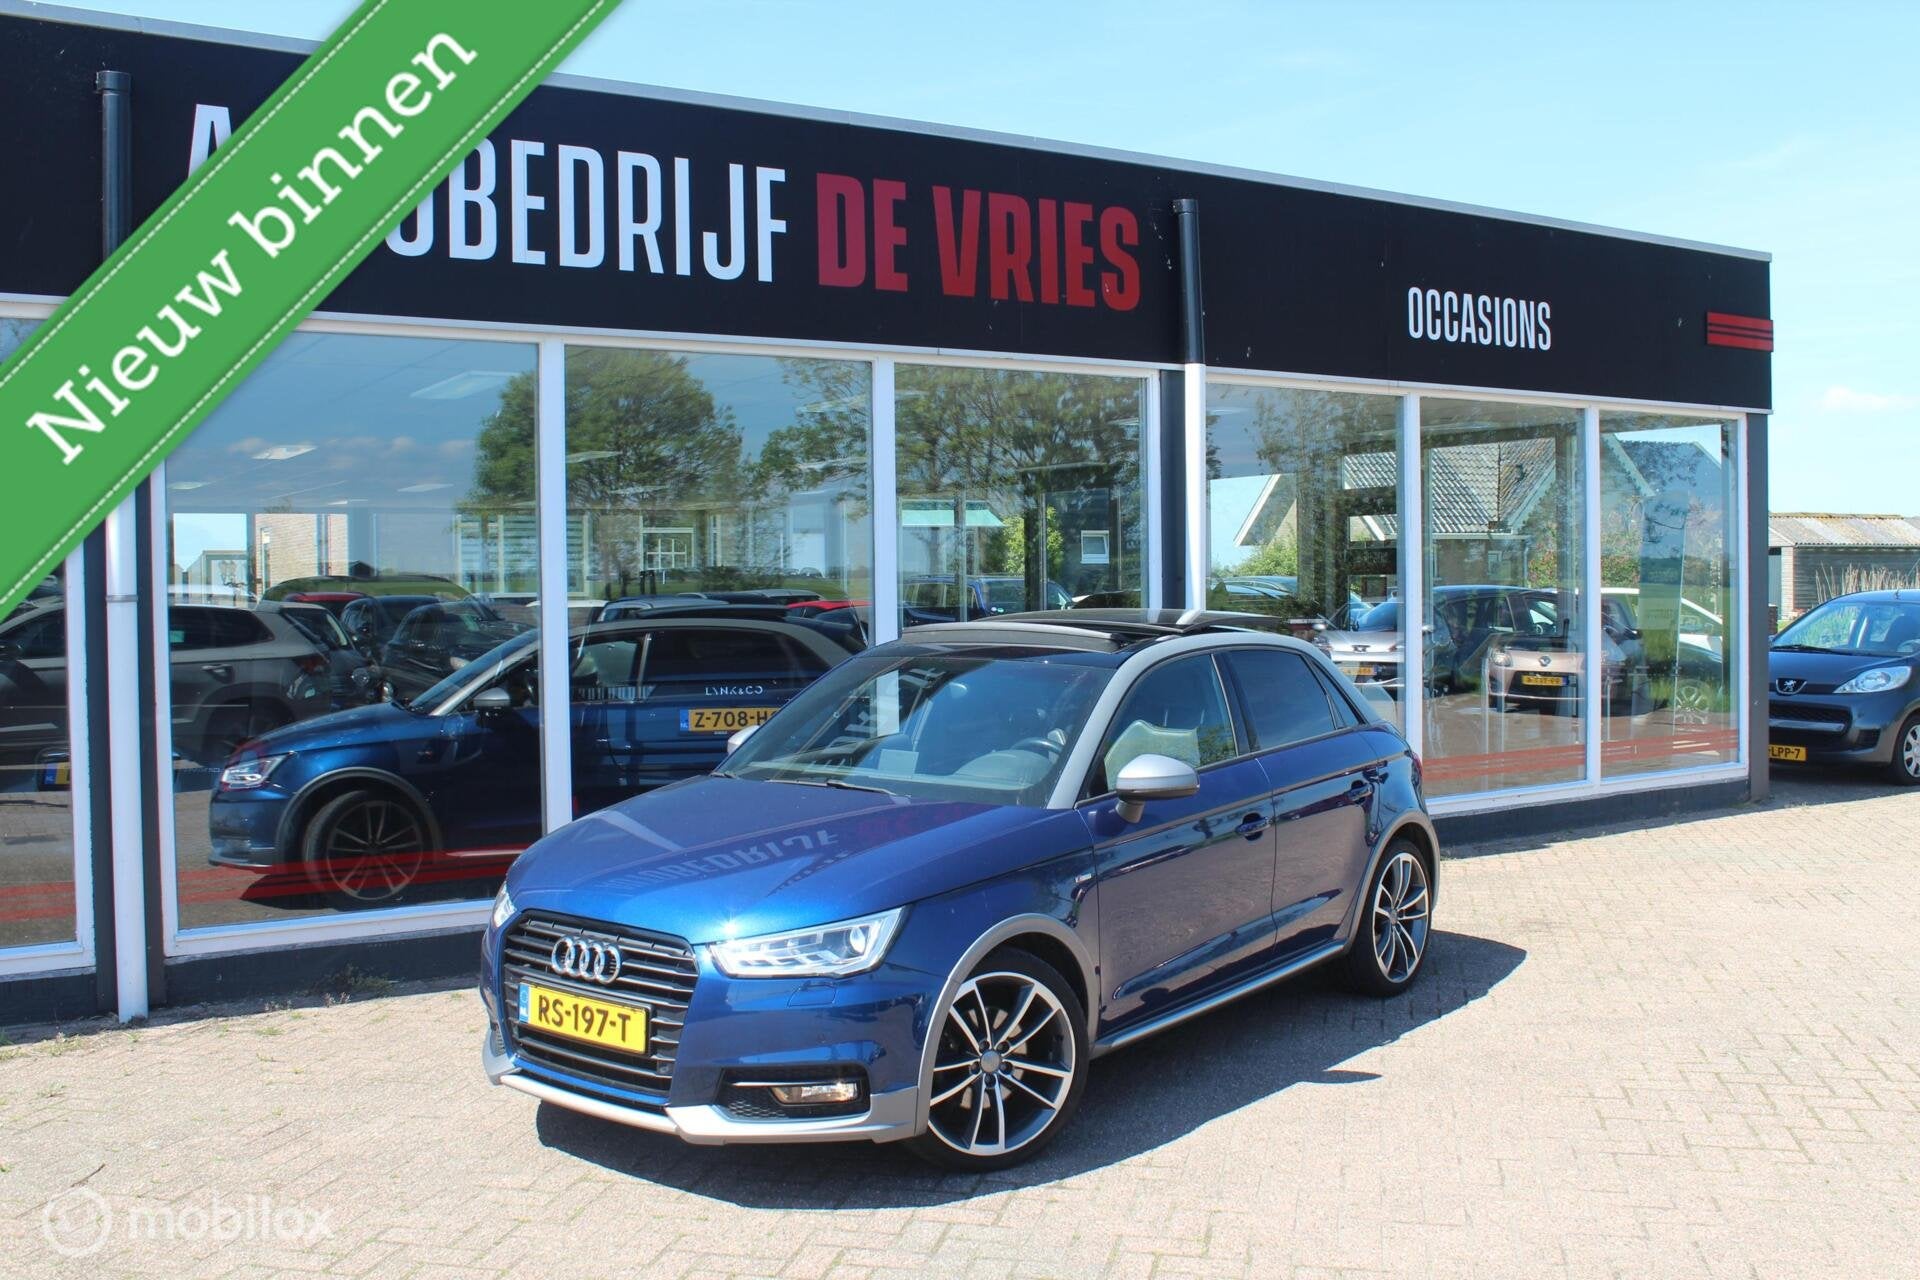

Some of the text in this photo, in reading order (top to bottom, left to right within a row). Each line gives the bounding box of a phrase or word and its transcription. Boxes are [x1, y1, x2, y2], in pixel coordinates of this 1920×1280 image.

[816, 172, 909, 292] DE
[932, 185, 1141, 312] VRIES
[1408, 286, 1552, 351] OCCASIONS
[538, 994, 631, 1042] RS-197-T
